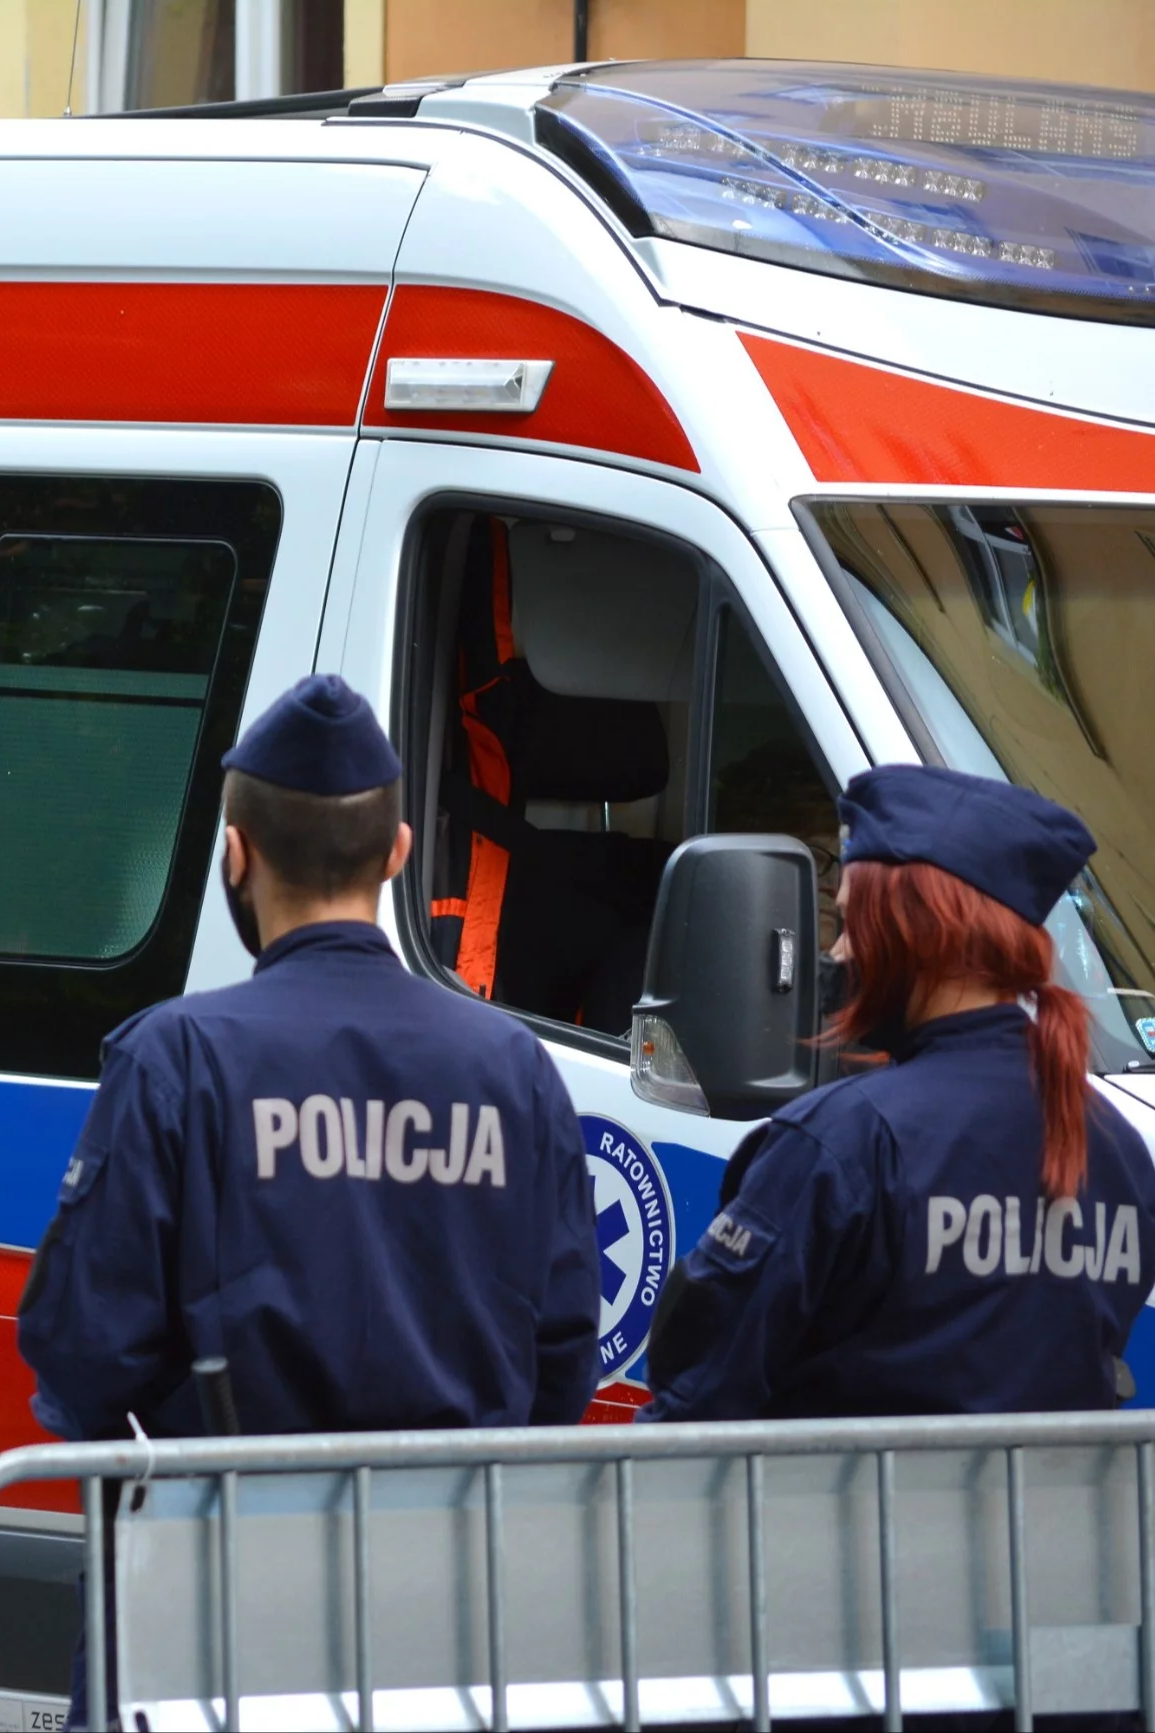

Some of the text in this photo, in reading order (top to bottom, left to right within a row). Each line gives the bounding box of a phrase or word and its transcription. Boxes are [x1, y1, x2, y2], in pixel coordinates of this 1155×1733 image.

[252, 1093, 507, 1188] POLICJA
[599, 1131, 663, 1307] RATOWNICTWO
[924, 1194, 1142, 1285] POLICJA
